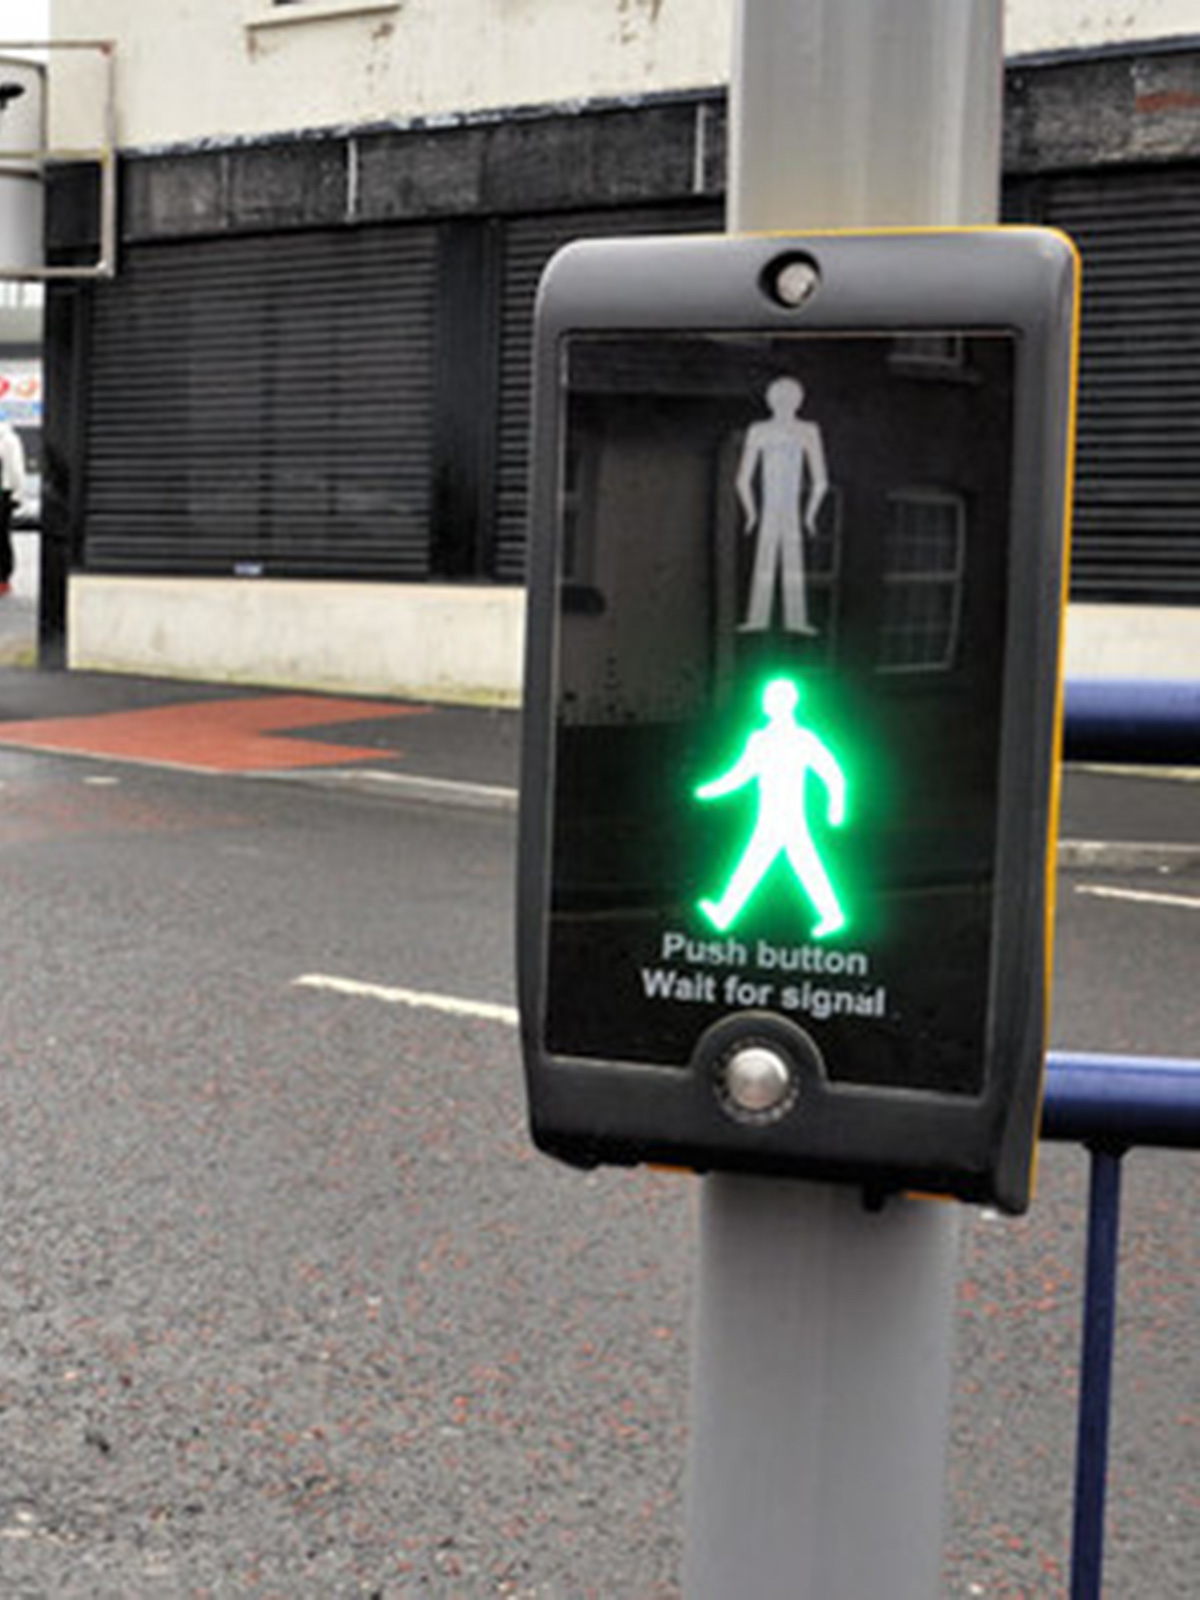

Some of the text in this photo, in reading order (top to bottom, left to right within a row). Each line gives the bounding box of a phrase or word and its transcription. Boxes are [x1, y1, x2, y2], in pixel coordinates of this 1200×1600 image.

[662, 932, 868, 976] Push button
[641, 968, 886, 1018] Wait for signal
